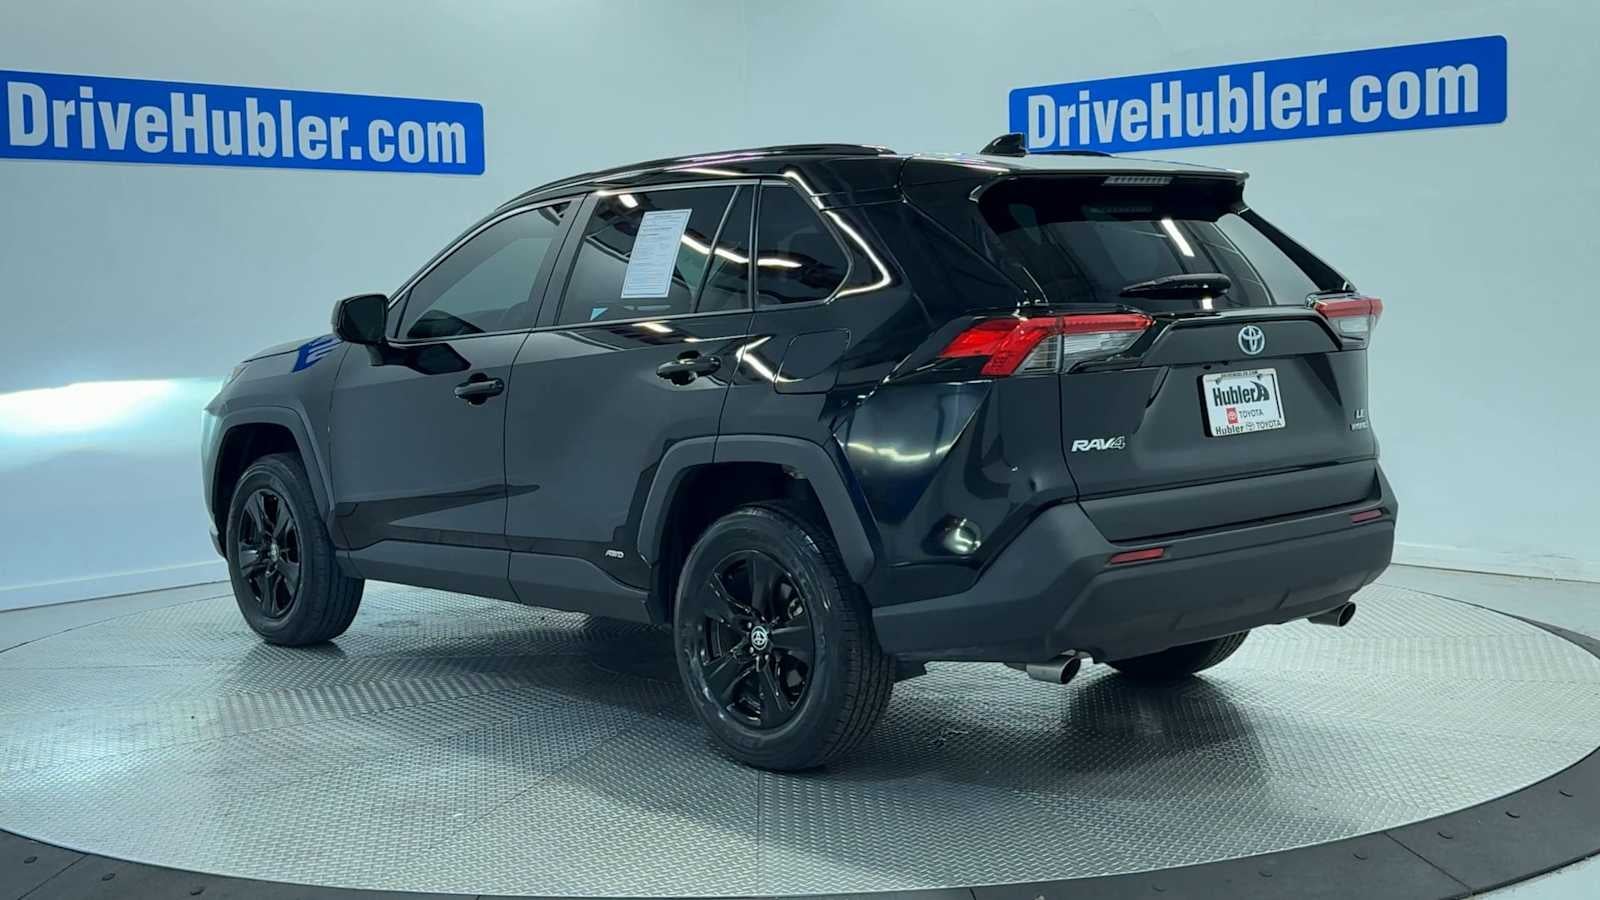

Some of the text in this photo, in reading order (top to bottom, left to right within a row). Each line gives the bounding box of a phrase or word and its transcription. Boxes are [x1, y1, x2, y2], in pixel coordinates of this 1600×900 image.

[1028, 62, 1480, 149] DriveHubler.com
[7, 81, 467, 164] DriveHubler.com
[1212, 385, 1256, 407] Hubler
[1238, 408, 1264, 418] TOYOTA
[1215, 419, 1282, 435] Hubler TOYOTA
[1071, 435, 1126, 452] RAV4
